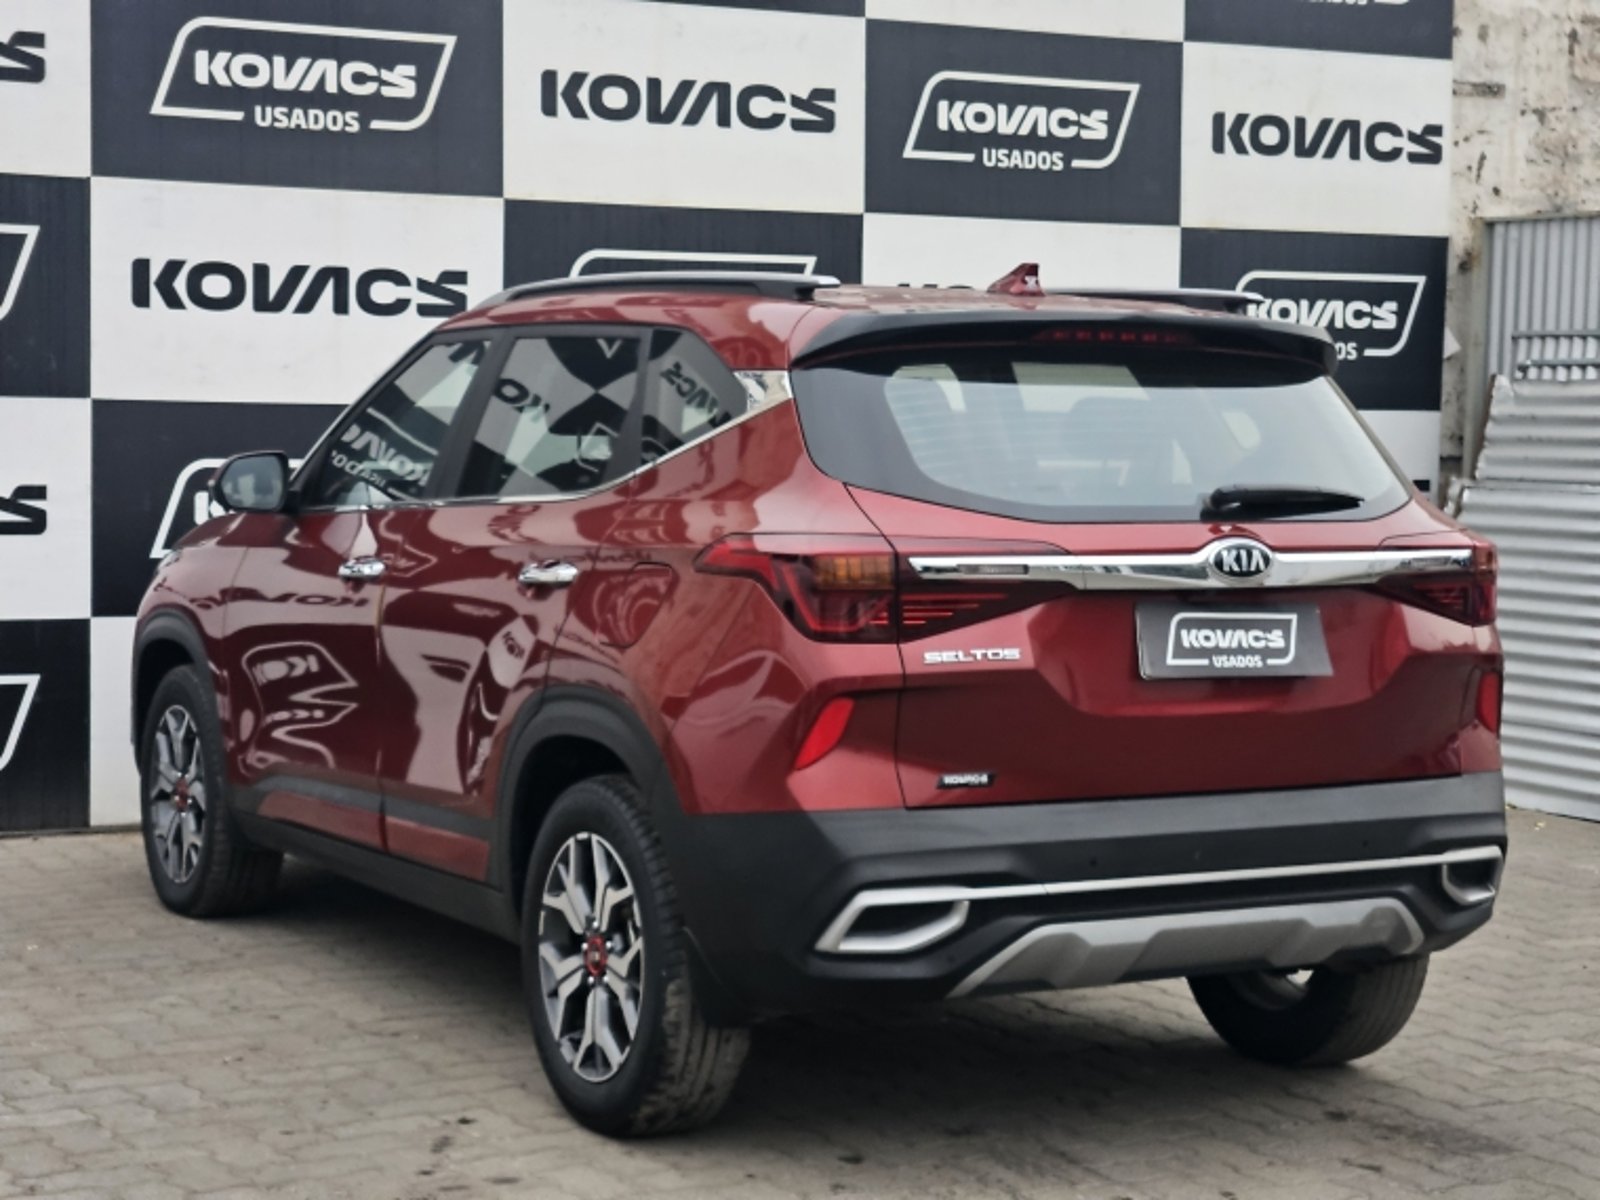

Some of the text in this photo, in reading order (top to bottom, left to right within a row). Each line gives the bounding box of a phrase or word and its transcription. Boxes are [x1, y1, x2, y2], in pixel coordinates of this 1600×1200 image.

[194, 49, 417, 99] KOVACS
[541, 69, 836, 133] KOVACS
[254, 104, 361, 133] USADOS
[937, 99, 1109, 140] KOVACS
[1211, 111, 1444, 165] KOVACS
[982, 147, 1064, 171] USADOS
[131, 257, 469, 318] KOVACS
[1220, 548, 1267, 573] KIA
[1180, 628, 1286, 649] KOVACS
[923, 648, 1021, 664] SELTOS
[1211, 654, 1264, 668] USADOS
